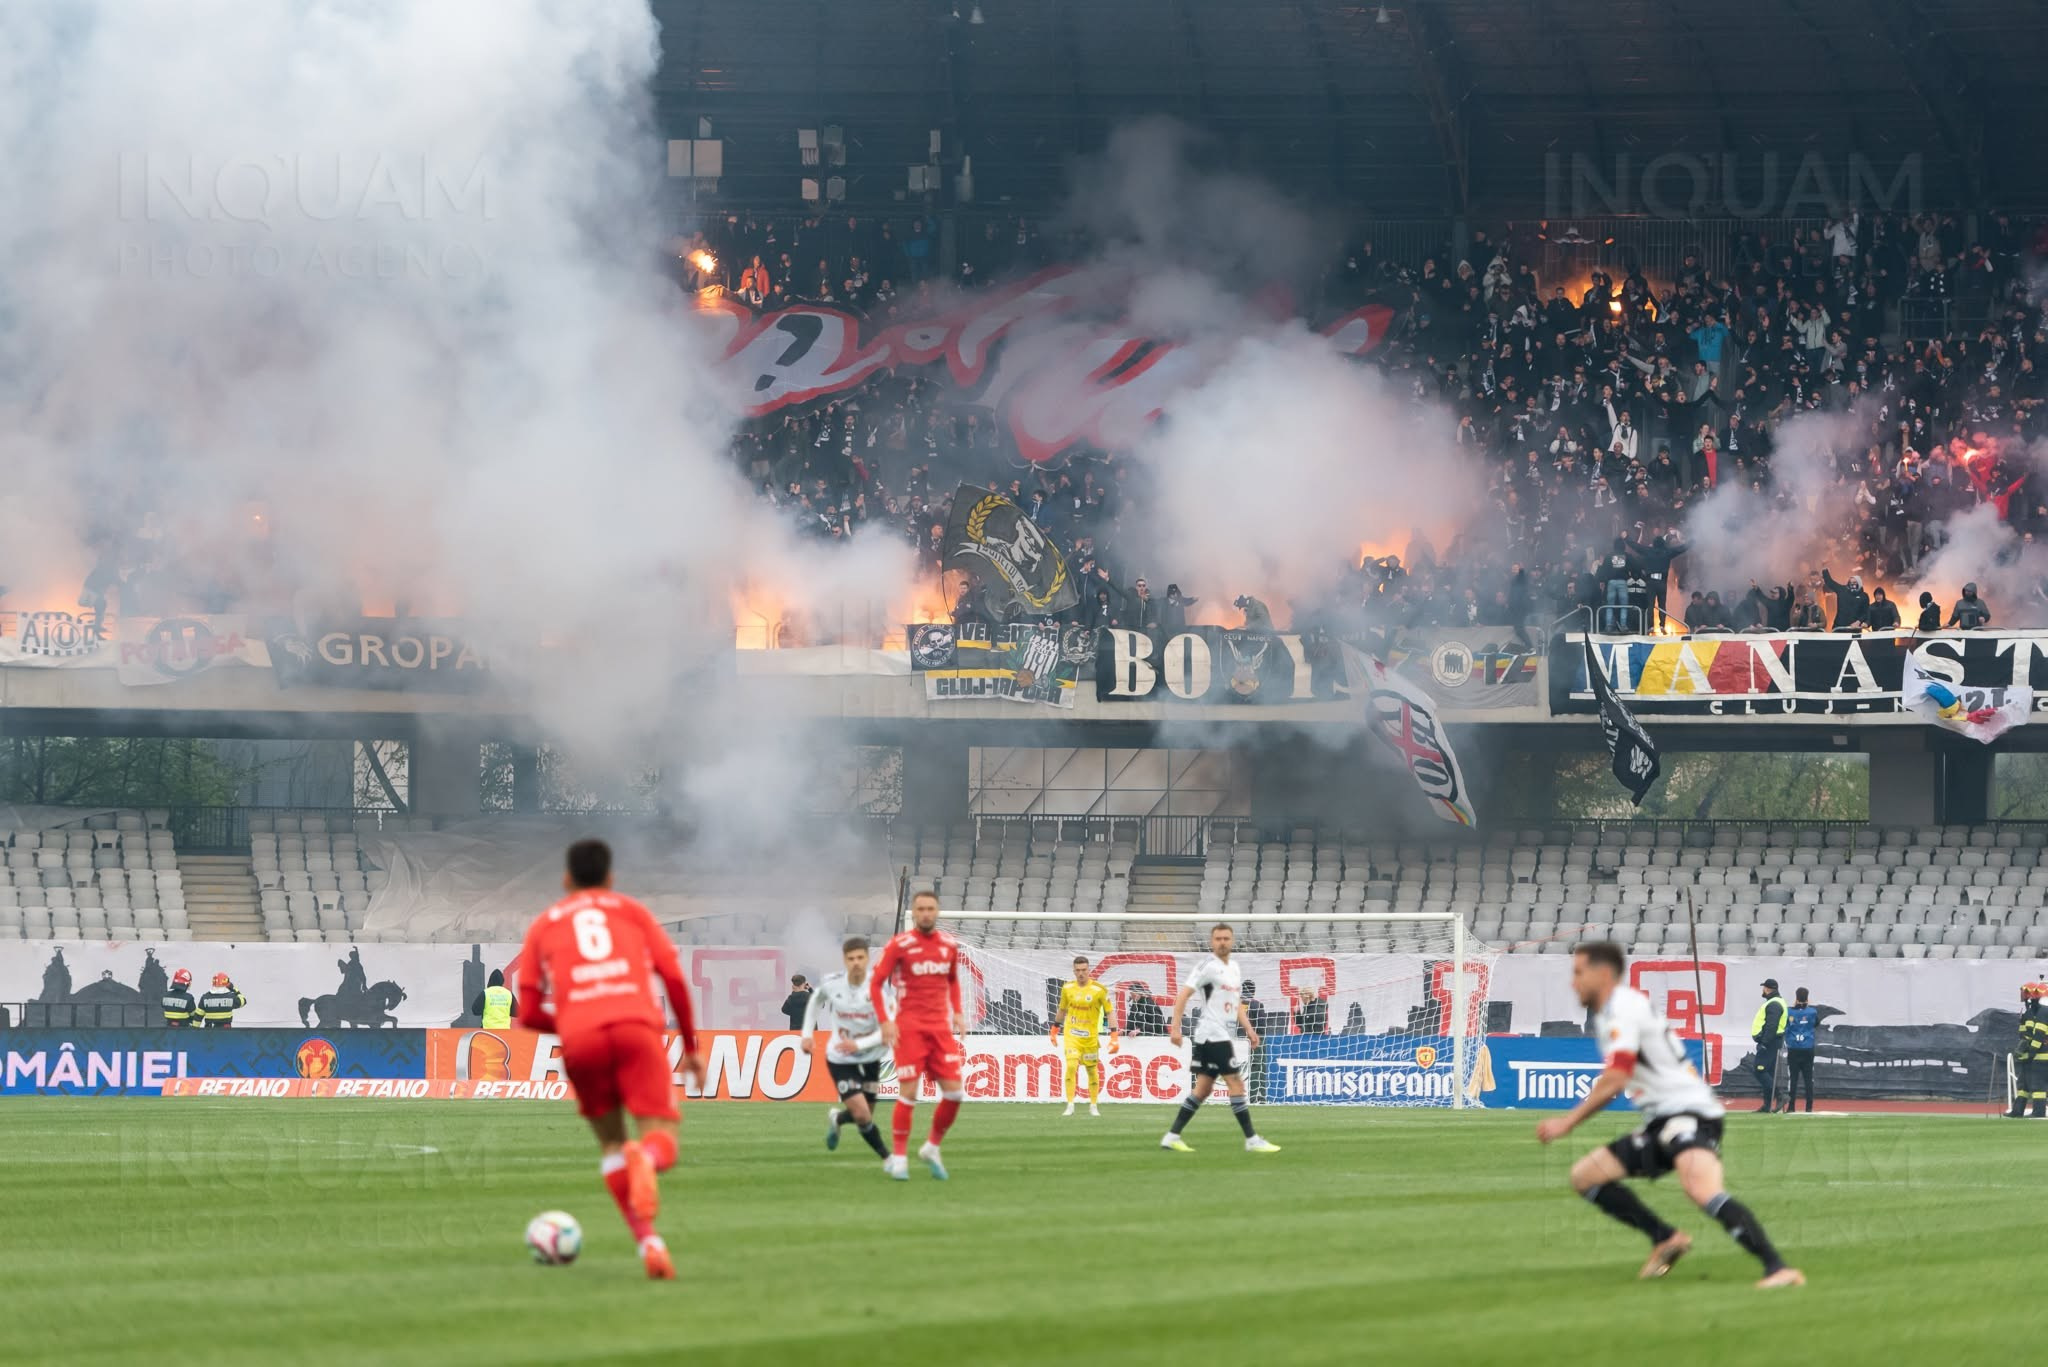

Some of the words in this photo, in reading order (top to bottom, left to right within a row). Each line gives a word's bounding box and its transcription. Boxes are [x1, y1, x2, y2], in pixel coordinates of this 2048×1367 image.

[573, 908, 612, 961] 6
[0, 1043, 188, 1088] MÂNIEI
[198, 1078, 290, 1098] BETANO
[335, 1079, 430, 1098] BETANO
[473, 1081, 569, 1100] BETANO
